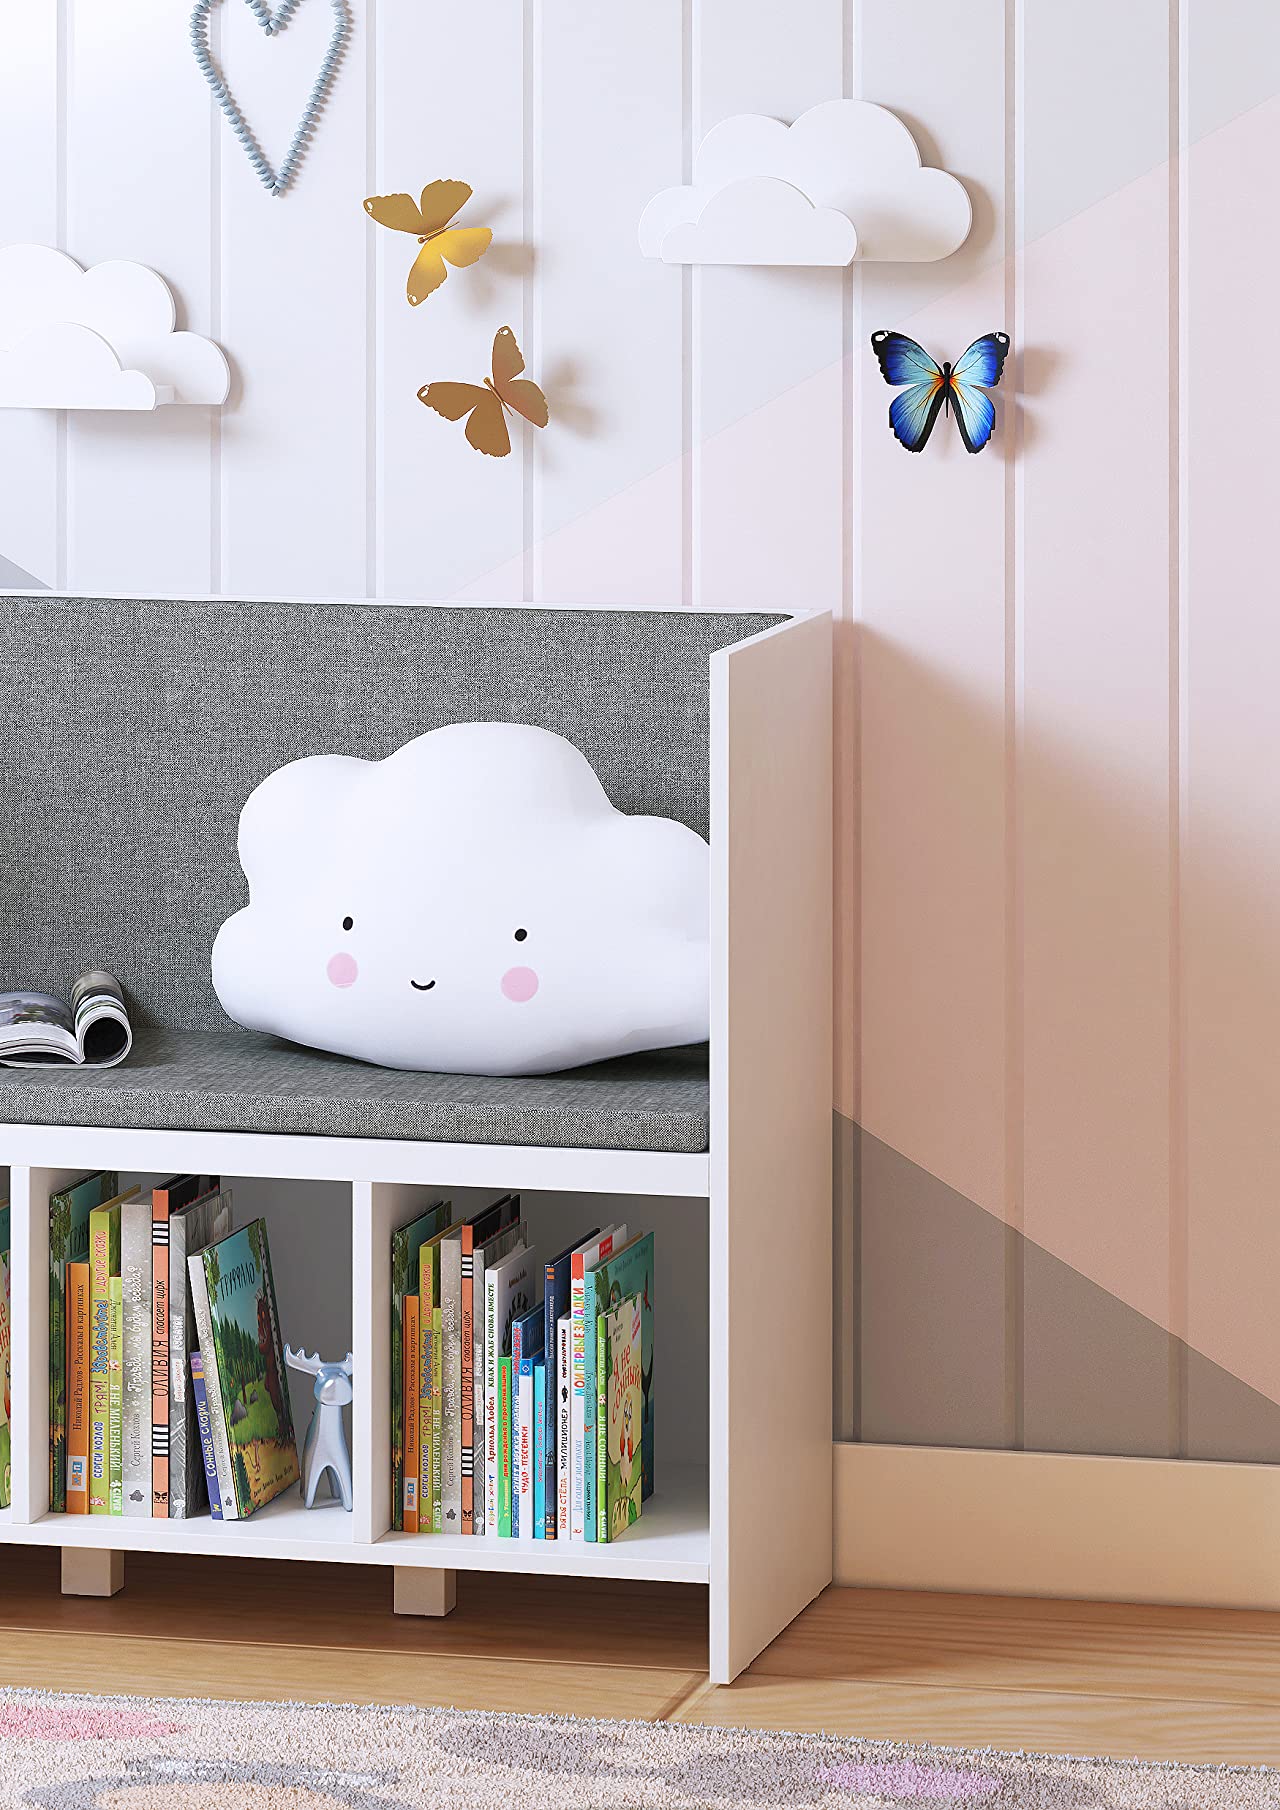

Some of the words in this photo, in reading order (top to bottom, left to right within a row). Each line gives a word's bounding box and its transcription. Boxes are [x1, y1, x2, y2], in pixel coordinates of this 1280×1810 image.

[76, 1284, 87, 1324] картинках
[156, 1279, 168, 1300] цирк
[156, 1301, 166, 1335] спасает
[463, 1310, 473, 1329] цирк
[572, 1287, 585, 1331] ЗАГАДКИ
[74, 1331, 84, 1365] Рассказы
[90, 1299, 109, 1375] Здравствуйте!
[463, 1330, 471, 1363] спасает
[573, 1333, 585, 1371] ПЕРВЫЕ
[72, 1370, 84, 1396] Радлов
[152, 1340, 168, 1397] ОЛИВИЯ
[408, 1359, 416, 1391] Рассказы
[90, 1381, 108, 1414] ТРЯМ!
[110, 1392, 120, 1406] НЕ
[461, 1367, 473, 1420] ОЛИВИЯ
[573, 1373, 585, 1397] МОИ
[72, 1398, 82, 1431] Николай
[420, 1405, 432, 1437] ТРЯМ!
[433, 1417, 440, 1430] НЕ
[486, 1396, 495, 1423] Лобел
[92, 1421, 104, 1450] КОЗЛОВ
[110, 1409, 124, 1471] МИЛЕНЬКИЙ!
[129, 1413, 141, 1440] Козлов
[407, 1422, 415, 1453] Николай
[560, 1408, 568, 1470] МИЛИЦИОНЕР
[599, 1424, 607, 1436] НЕ
[129, 1440, 144, 1467] Сергей
[421, 1444, 429, 1472] КОЗЛОВ
[487, 1425, 496, 1463] Арнольд
[501, 1427, 509, 1463] рождения
[520, 1425, 529, 1466] ПЕСЕНКИ
[433, 1431, 442, 1490] МИЛЕНЬКИЙ!
[446, 1462, 457, 1487] Сергей
[521, 1471, 530, 1494] ЧУДО
